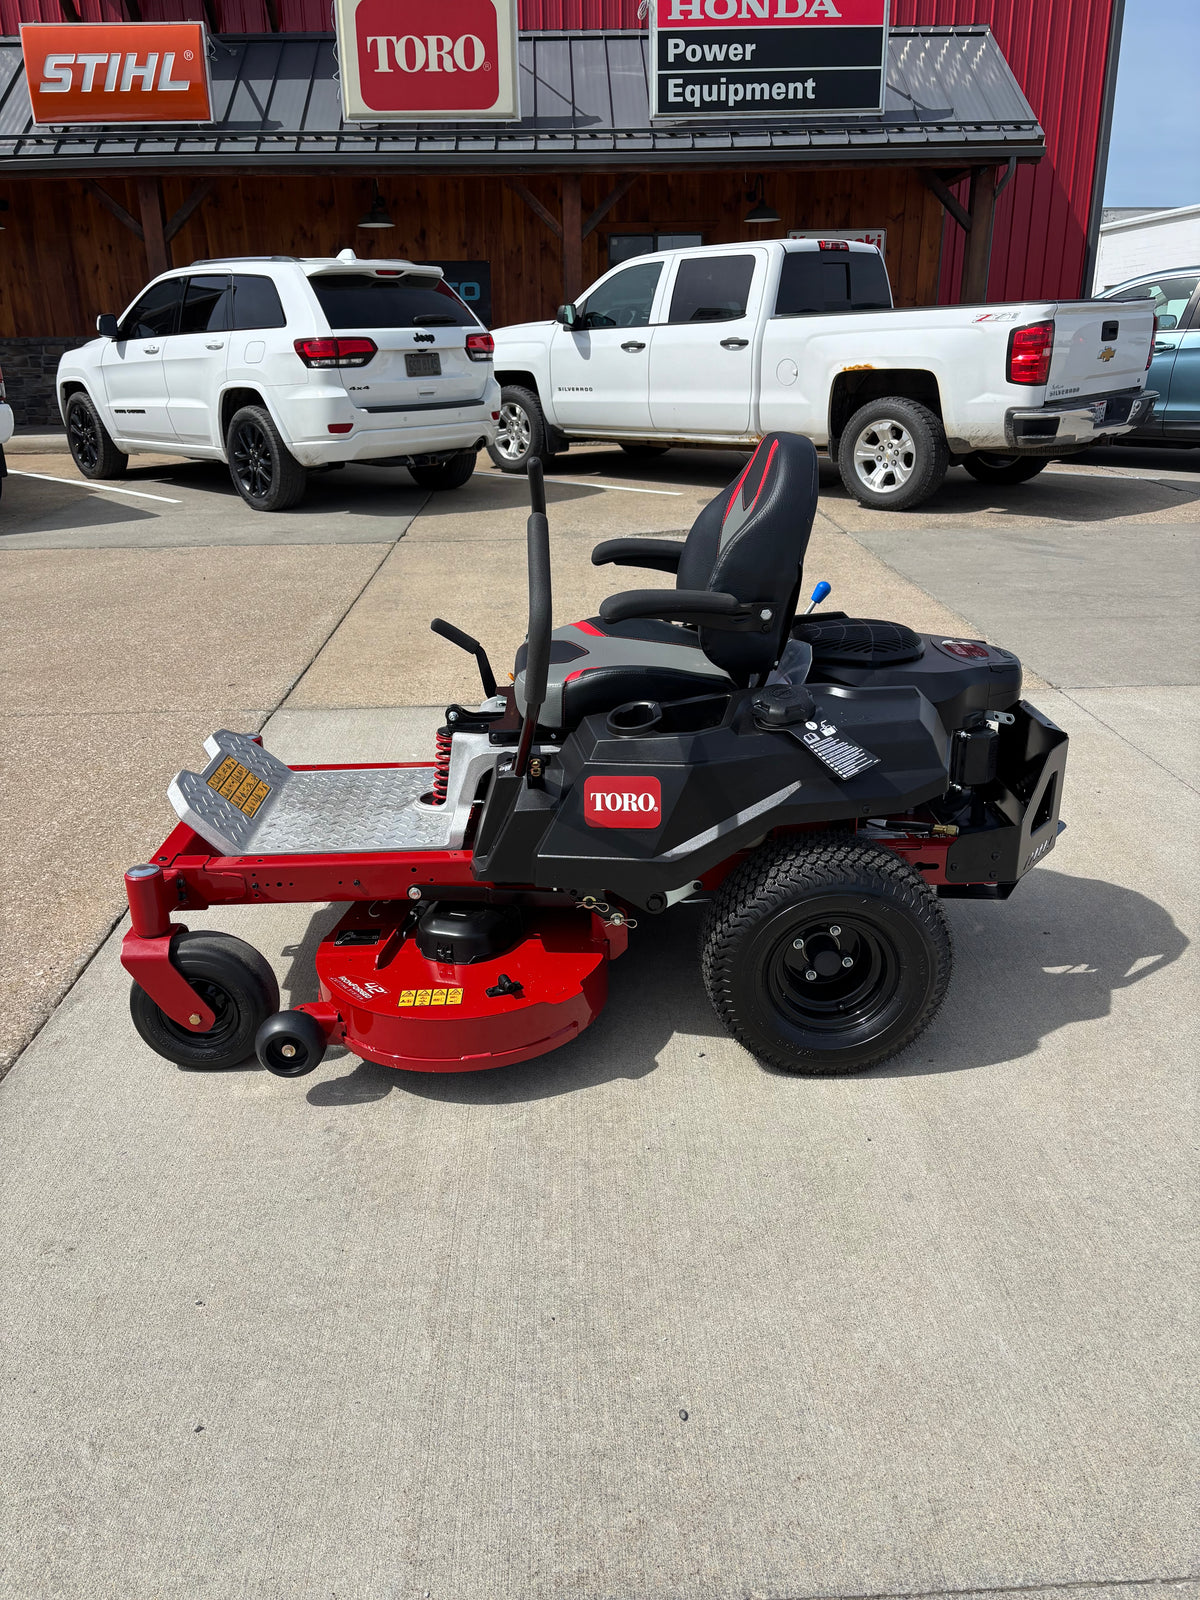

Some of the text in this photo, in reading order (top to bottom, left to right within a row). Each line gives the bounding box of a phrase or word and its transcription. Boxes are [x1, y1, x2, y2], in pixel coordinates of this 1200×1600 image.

[667, 0, 842, 20] HONDA
[366, 34, 486, 73] TORO
[667, 38, 757, 63] Power
[39, 52, 191, 93] STIHL
[667, 77, 816, 107] Equipment
[413, 332, 436, 344] Jeep
[590, 792, 656, 812] TORO
